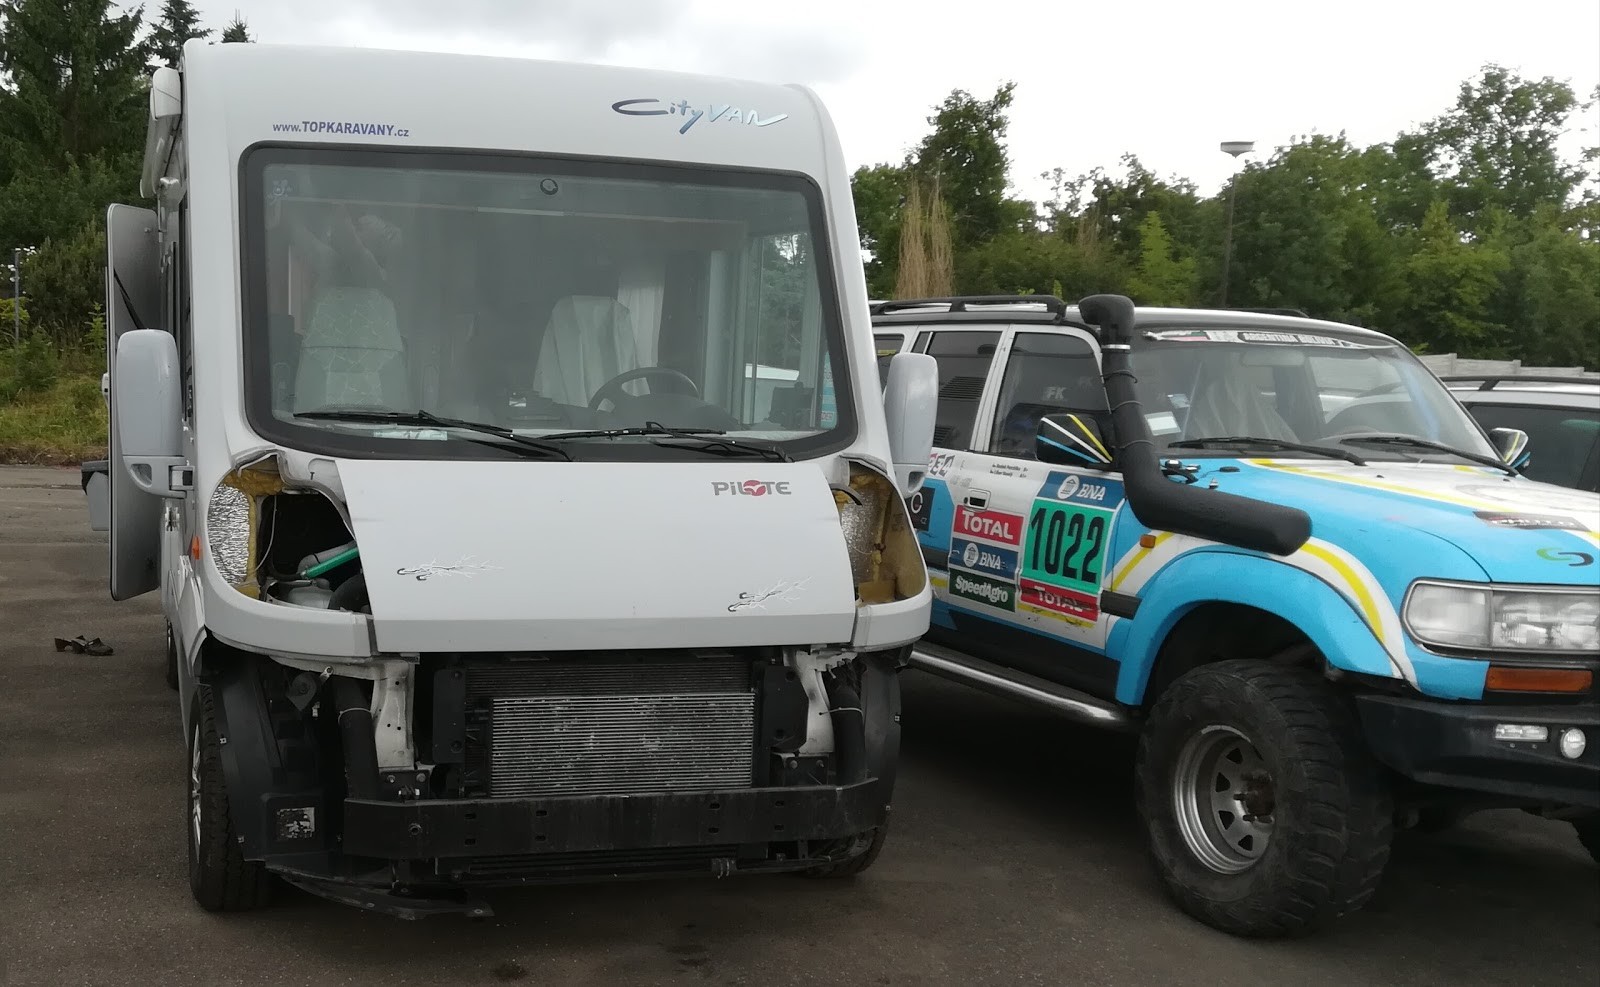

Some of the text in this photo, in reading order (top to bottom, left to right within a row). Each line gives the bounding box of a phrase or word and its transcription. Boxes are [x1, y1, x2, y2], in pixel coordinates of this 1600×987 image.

[273, 121, 409, 137] www.TOPKARAVANY.cz
[1076, 483, 1106, 501] BNA
[1031, 507, 1105, 584] 1022
[978, 552, 1002, 570] BNA
[955, 575, 1009, 603] SpeedAgro
